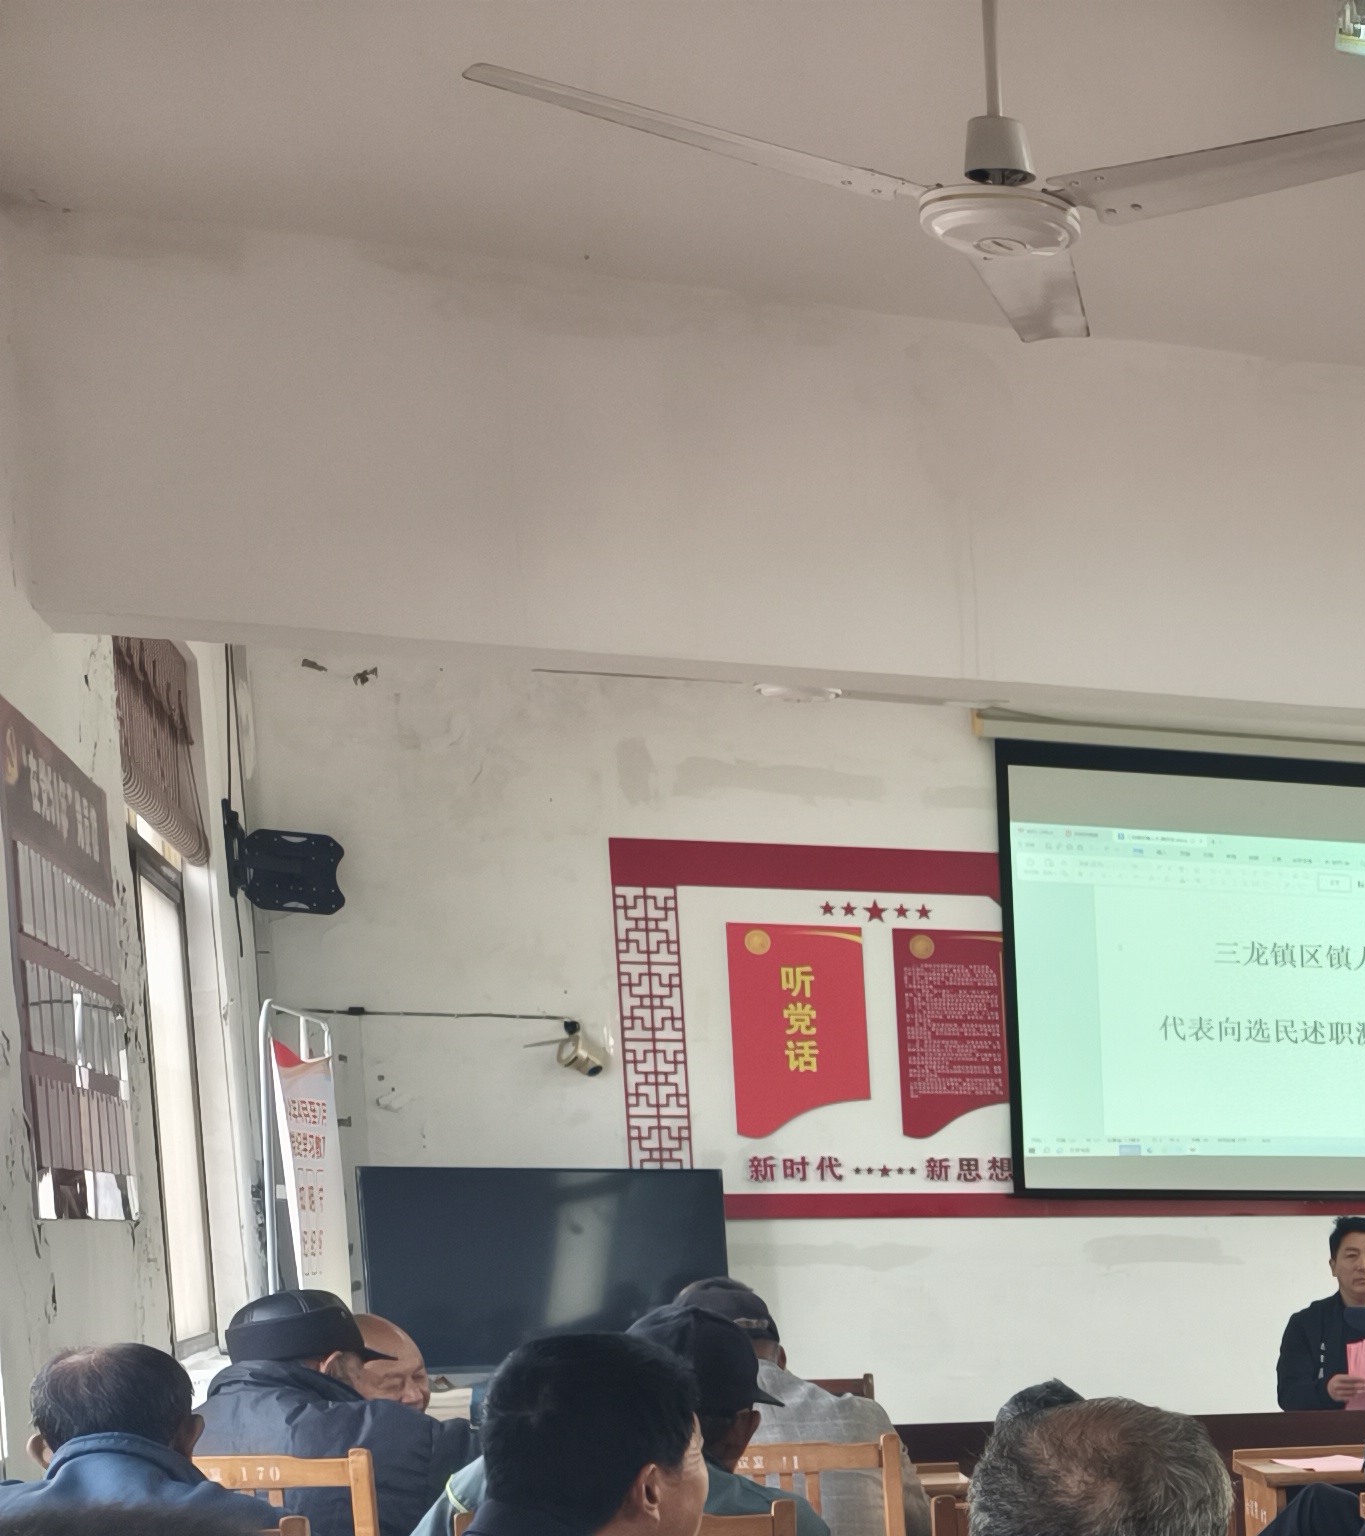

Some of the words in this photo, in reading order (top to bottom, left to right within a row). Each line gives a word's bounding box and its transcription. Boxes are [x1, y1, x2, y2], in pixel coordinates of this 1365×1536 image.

[780, 965, 819, 1073] 听党话
[749, 1155, 844, 1182] 新时代
[926, 1156, 1015, 1183] 新思想
[240, 1466, 281, 1482] 170
